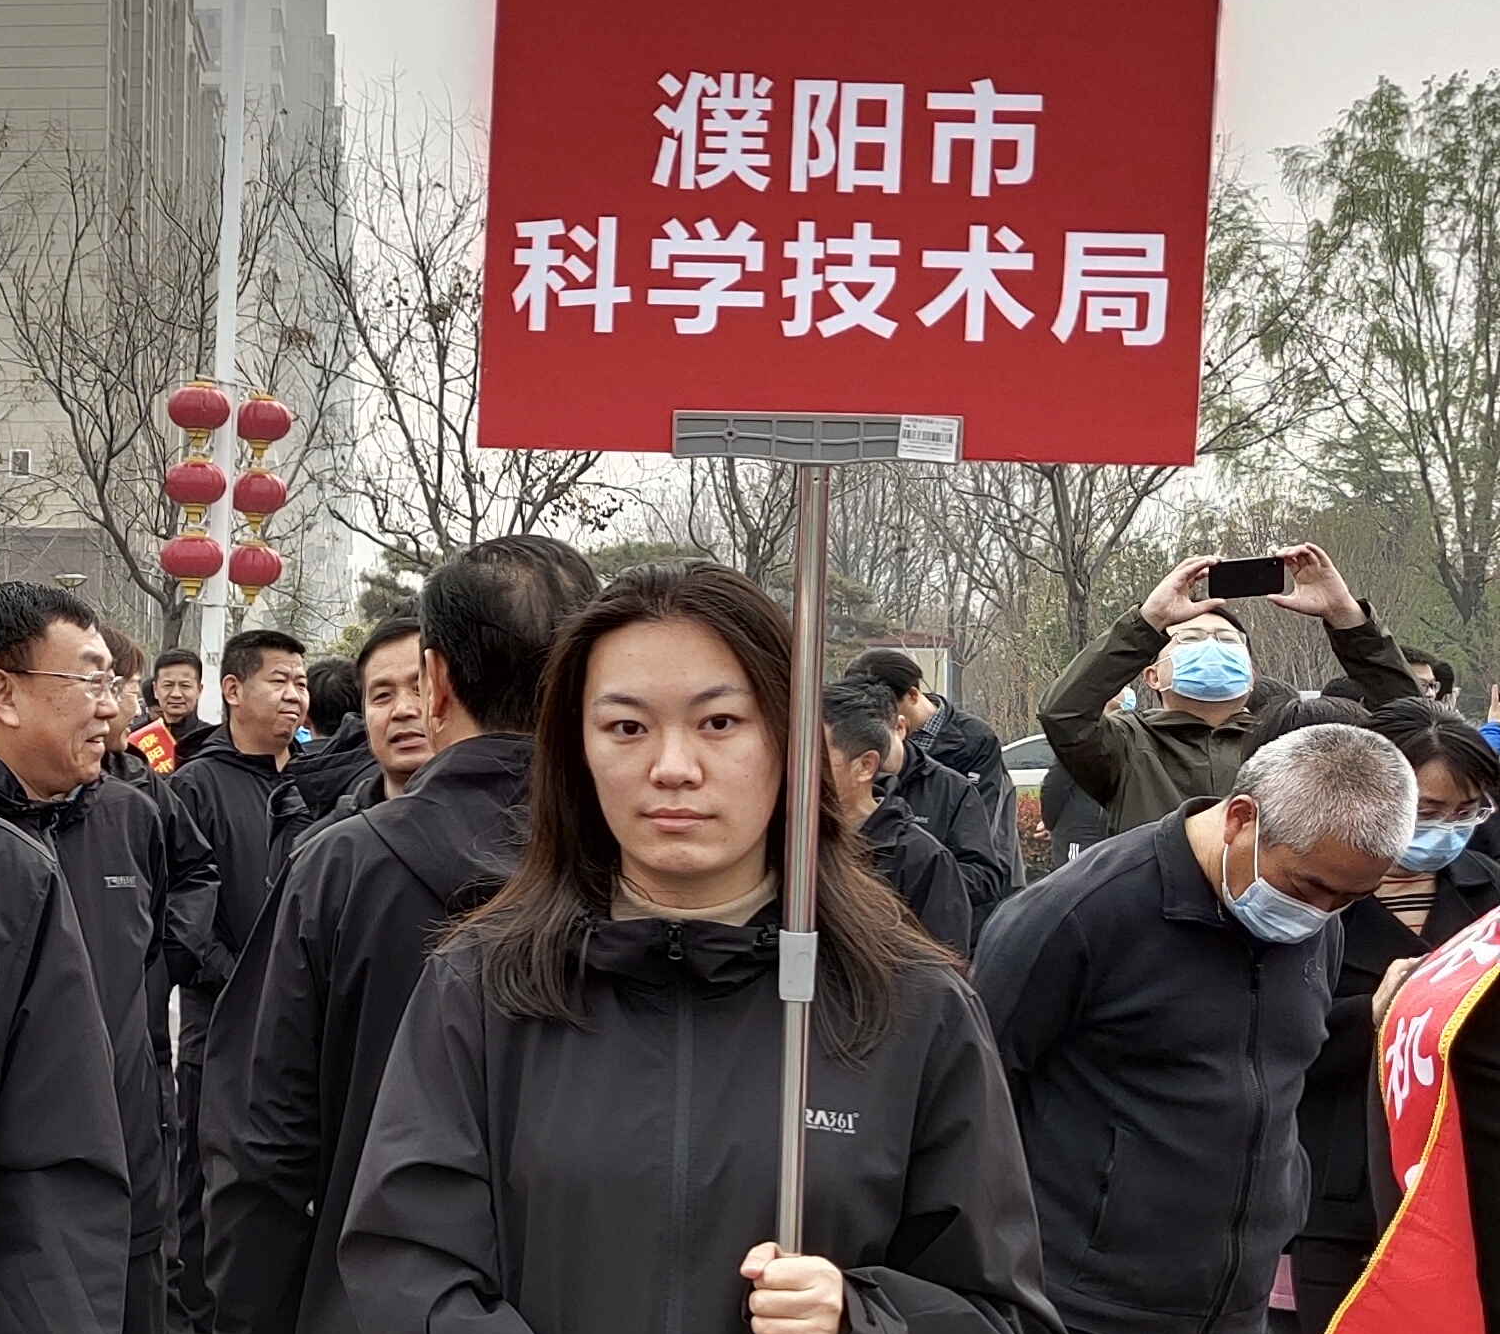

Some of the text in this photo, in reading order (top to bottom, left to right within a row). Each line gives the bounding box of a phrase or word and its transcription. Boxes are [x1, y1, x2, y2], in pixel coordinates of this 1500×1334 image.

[651, 70, 1043, 197] 濮阳市
[511, 215, 1170, 347] 科学技术局
